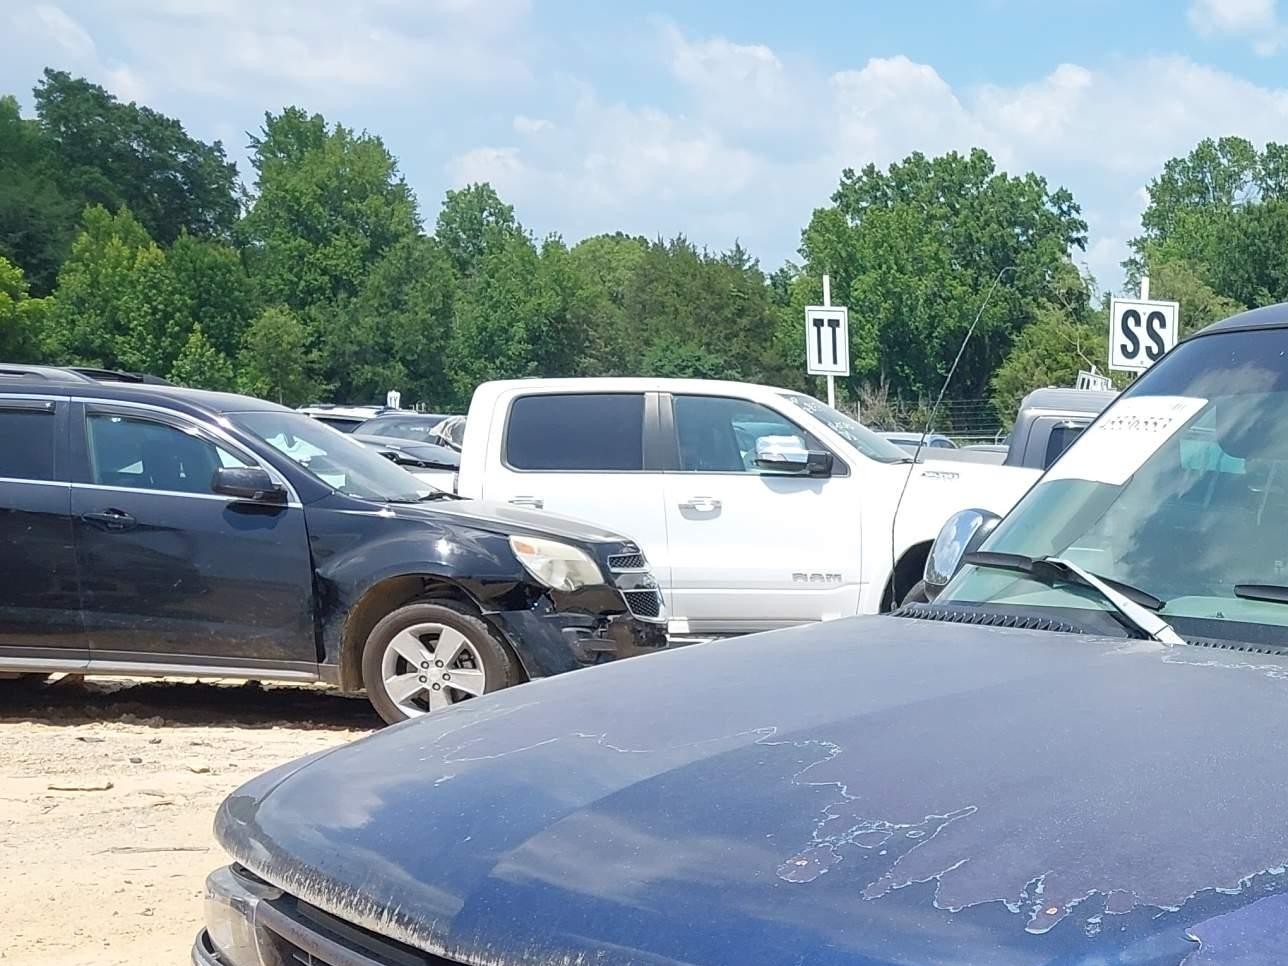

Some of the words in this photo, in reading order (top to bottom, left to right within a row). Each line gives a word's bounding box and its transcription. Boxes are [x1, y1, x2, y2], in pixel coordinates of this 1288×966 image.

[812, 318, 840, 365] TT
[1120, 309, 1167, 362] SS
[792, 572, 842, 584] RAM
